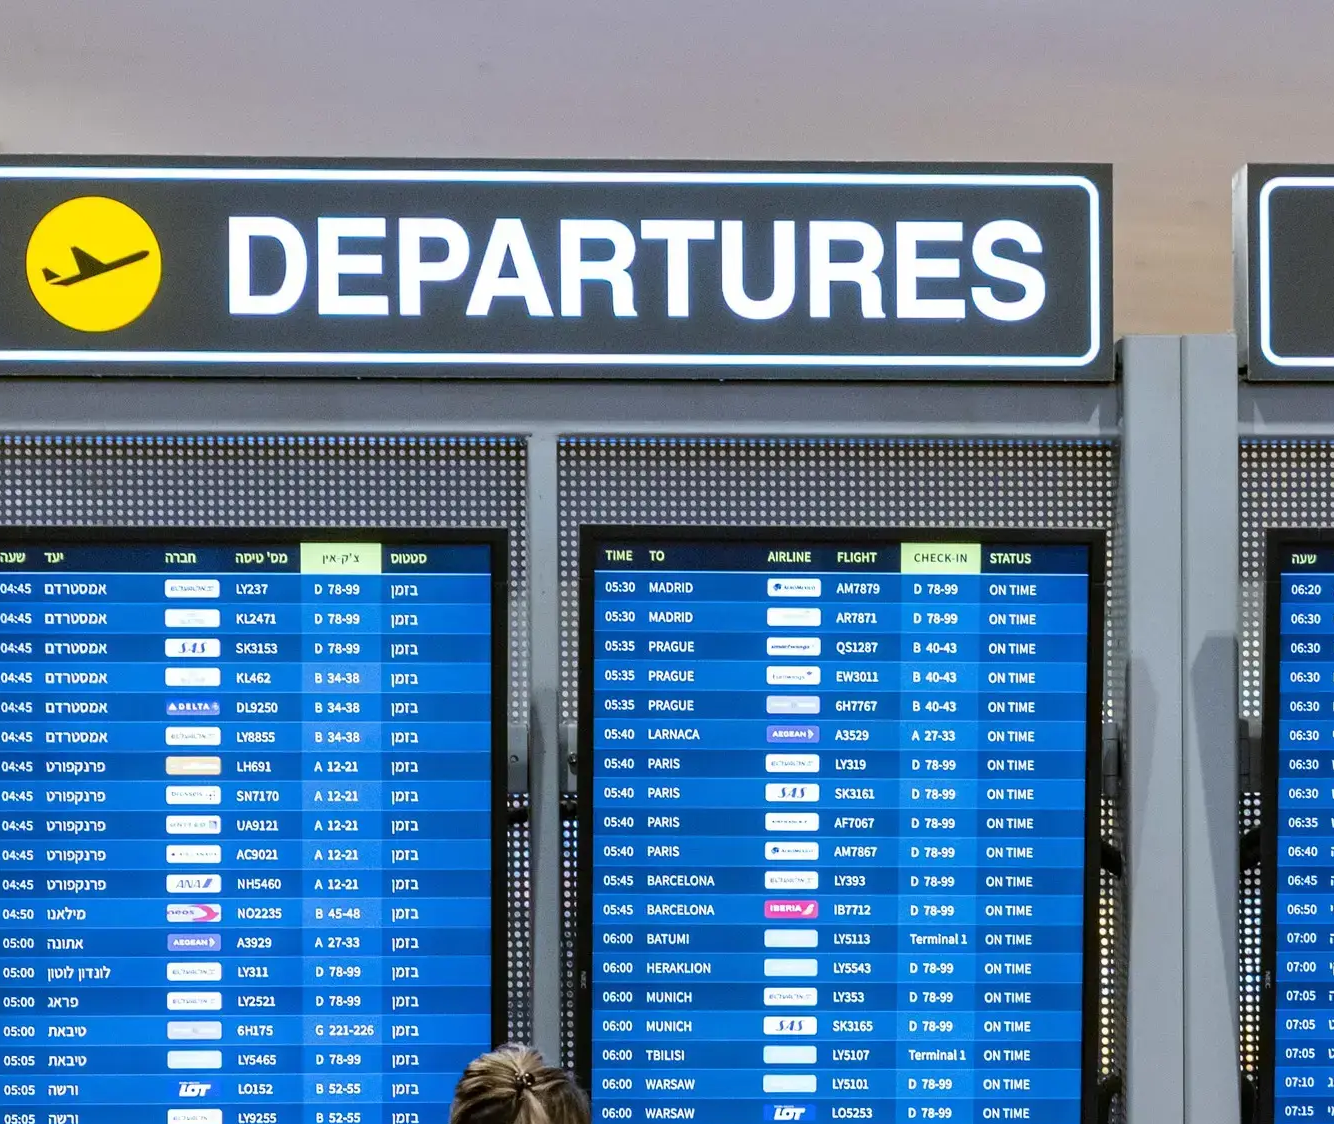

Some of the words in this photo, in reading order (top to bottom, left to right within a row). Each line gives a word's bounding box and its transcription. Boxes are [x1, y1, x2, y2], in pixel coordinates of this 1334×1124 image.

[228, 216, 1046, 321] DEPARTURES
[0, 552, 26, 563] שעה
[43, 552, 64, 563] יעד
[165, 552, 197, 564] חברה
[235, 553, 265, 564] טיסה
[390, 553, 427, 564] סטטוס
[605, 549, 633, 561] TIME
[648, 550, 665, 562] TO
[767, 551, 812, 563] AIRLINE
[837, 551, 878, 563] FLIGHT
[913, 552, 968, 564] CHECK-IN
[989, 552, 1032, 564] STATUS
[1291, 553, 1317, 565] שעה
[0, 583, 32, 594] 04:45
[44, 583, 107, 595] אמסטרדם
[236, 583, 268, 595] LY237
[314, 583, 323, 595] D
[327, 583, 360, 595] 78-99
[391, 584, 419, 599] בזמן
[605, 581, 636, 593] 05:30
[649, 581, 694, 593] MADRID
[836, 582, 880, 595] AM7879
[913, 583, 922, 595] D
[927, 583, 959, 595] 78-99
[989, 584, 1007, 596] ON
[1009, 584, 1037, 596] TIME
[1291, 584, 1322, 595] 06:20
[604, 728, 635, 740] 05:40
[648, 728, 700, 740] LARNACA
[771, 729, 807, 739] AEGEAN
[834, 729, 870, 741] A3529
[911, 730, 920, 741] A
[924, 730, 956, 742] 27-33
[987, 730, 1005, 742] ON
[1007, 730, 1035, 742] TIME
[1288, 817, 1318, 828] 06:35
[2, 879, 34, 890] 04:45
[46, 879, 107, 894] פרנקפורט
[237, 878, 282, 890] NH5460
[314, 879, 323, 890] A
[327, 878, 359, 890] 12-21
[391, 879, 419, 894] בזמן
[602, 1049, 633, 1061] 06:00
[645, 1049, 685, 1061] TBILISI
[832, 1049, 870, 1061] LY5107
[908, 1049, 958, 1061] Terminal
[959, 1049, 966, 1061] 1
[983, 1049, 1001, 1061] ON
[1003, 1049, 1031, 1061] TIME
[1285, 1047, 1316, 1059] 07:05
[3, 1084, 36, 1096] 05:05
[48, 1085, 79, 1096] ורשה
[178, 1083, 212, 1098] LOT
[316, 1083, 324, 1095] B
[328, 1083, 361, 1094] 52-55
[392, 1083, 420, 1098] בזמן
